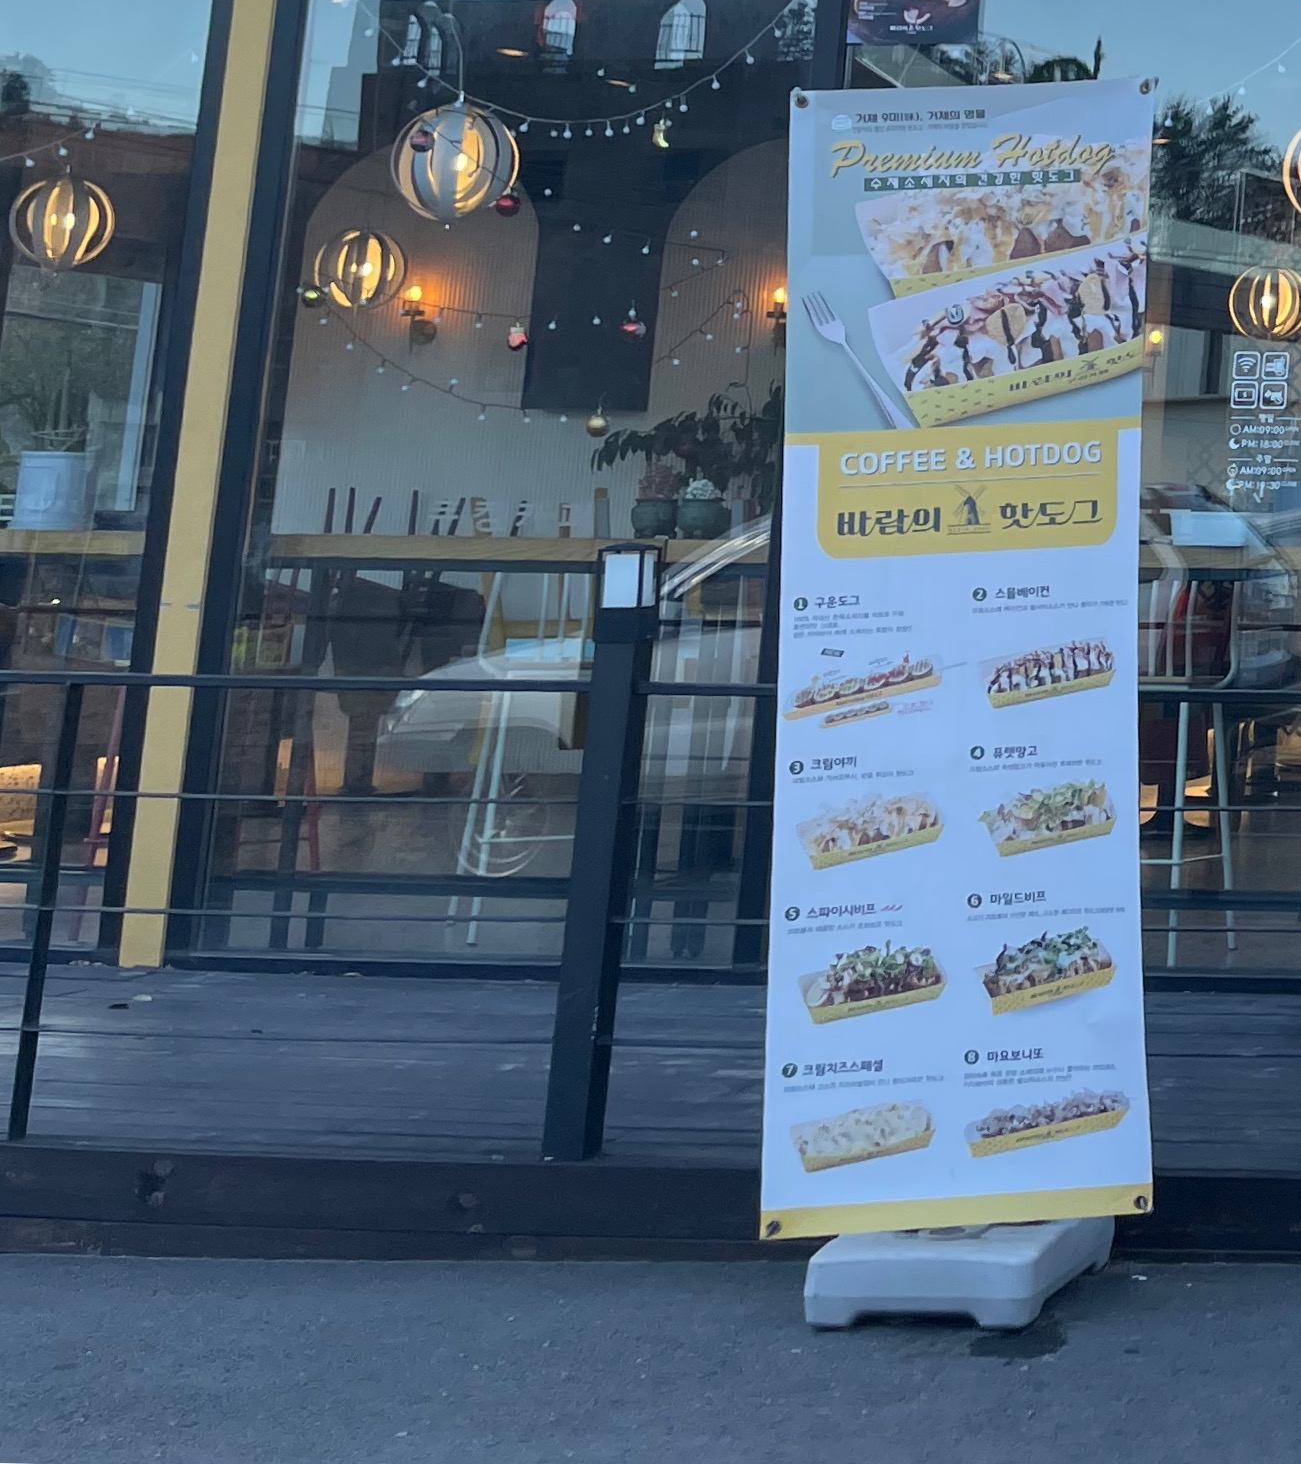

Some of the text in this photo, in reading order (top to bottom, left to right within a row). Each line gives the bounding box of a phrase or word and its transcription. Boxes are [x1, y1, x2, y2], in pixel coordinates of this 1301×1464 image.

[855, 113, 878, 123] 거제
[926, 110, 961, 121] 거제의
[963, 109, 987, 120] 명물
[831, 133, 1116, 179] Premium Hotdog
[869, 169, 1075, 190] 수제소세지의 건강한 핫도그
[839, 440, 1103, 476] COFFEE & HOTDOG
[836, 499, 1104, 537] 바람의 핫도그
[814, 595, 861, 609] 구운도그
[993, 745, 1039, 759] 퓨렛망고
[810, 755, 858, 771] 크림야끼
[990, 890, 1047, 906] 마일드비프
[805, 903, 877, 919] 스파이시비프
[987, 1047, 1044, 1063] 마요보니또
